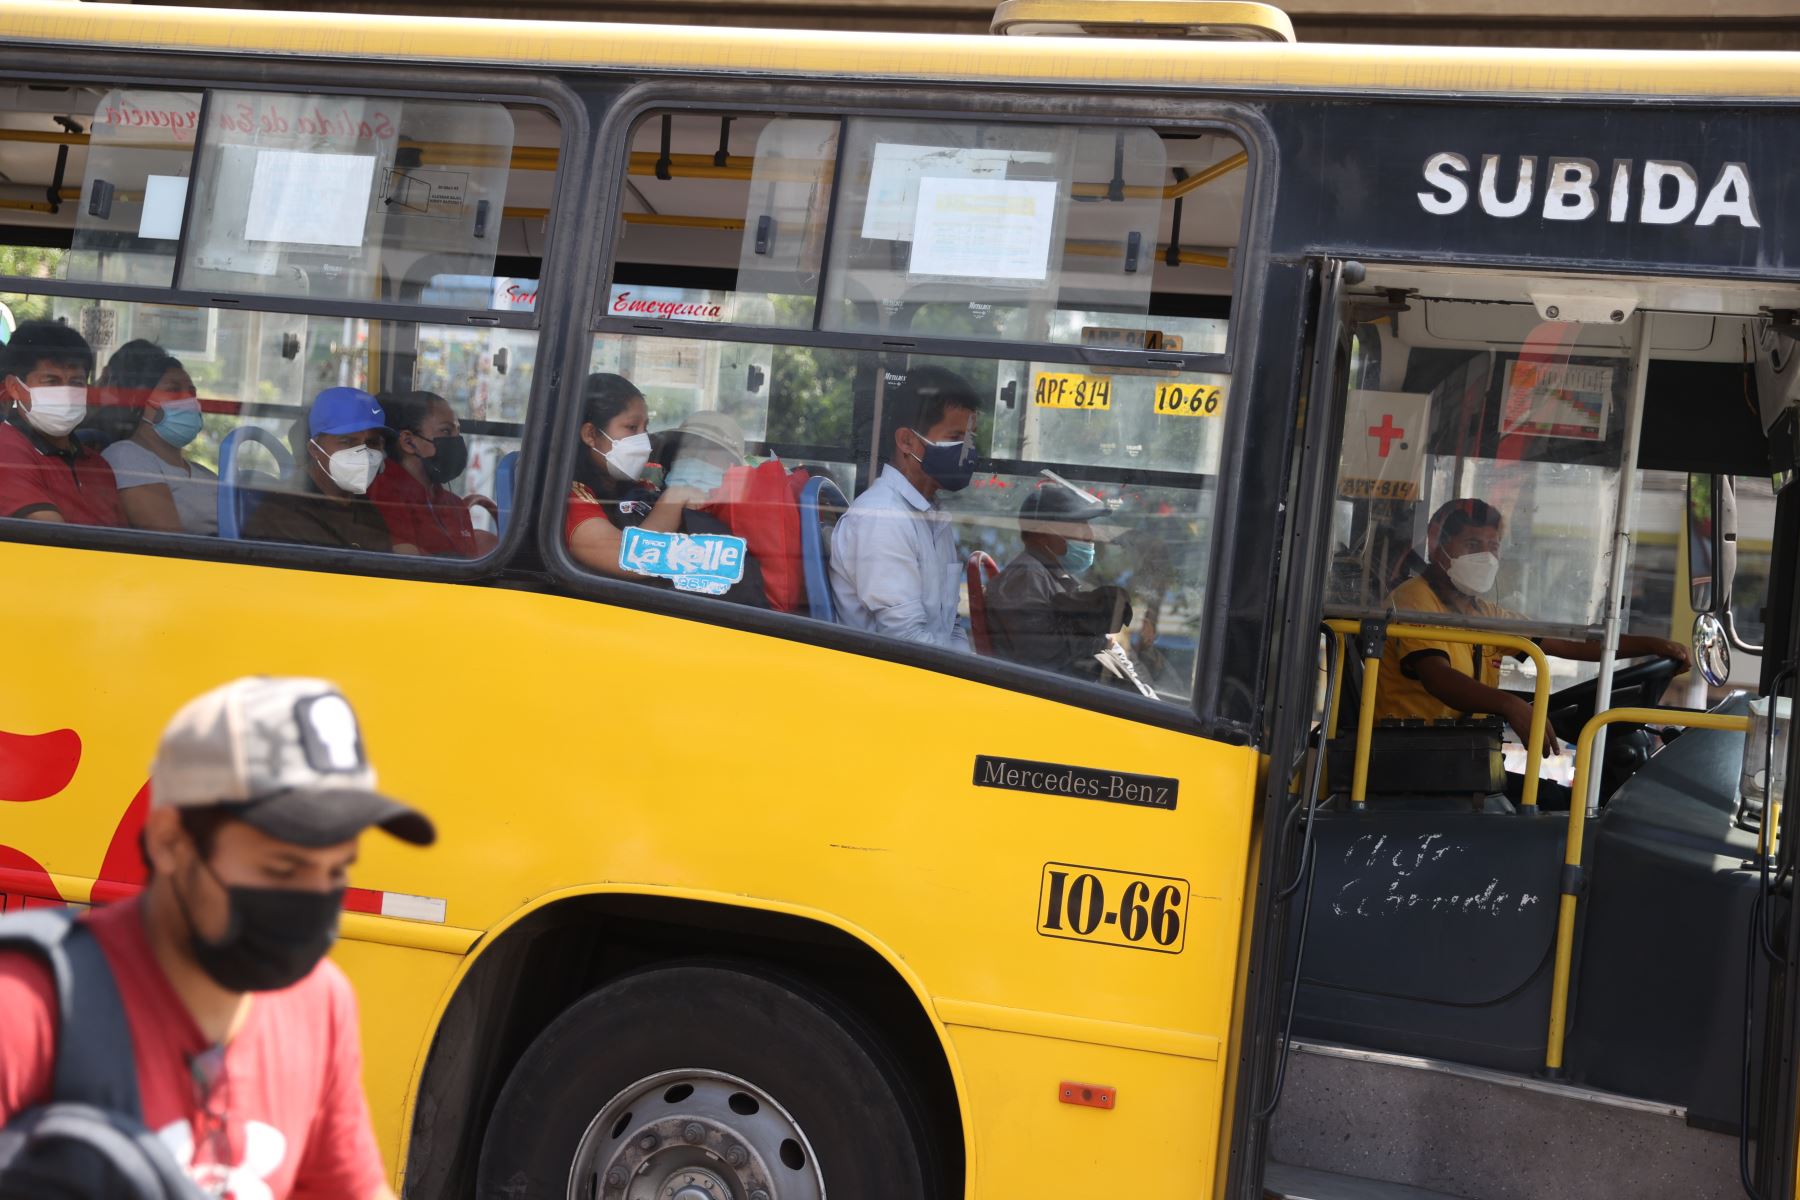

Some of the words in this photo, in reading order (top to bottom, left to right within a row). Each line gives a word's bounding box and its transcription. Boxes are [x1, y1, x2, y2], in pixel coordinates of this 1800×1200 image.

[1417, 152, 1761, 228] SUBIDA
[506, 285, 538, 304] Sal
[613, 291, 722, 319] Emergencia
[627, 535, 661, 563] La
[983, 760, 1169, 805] Mercedes-Benz
